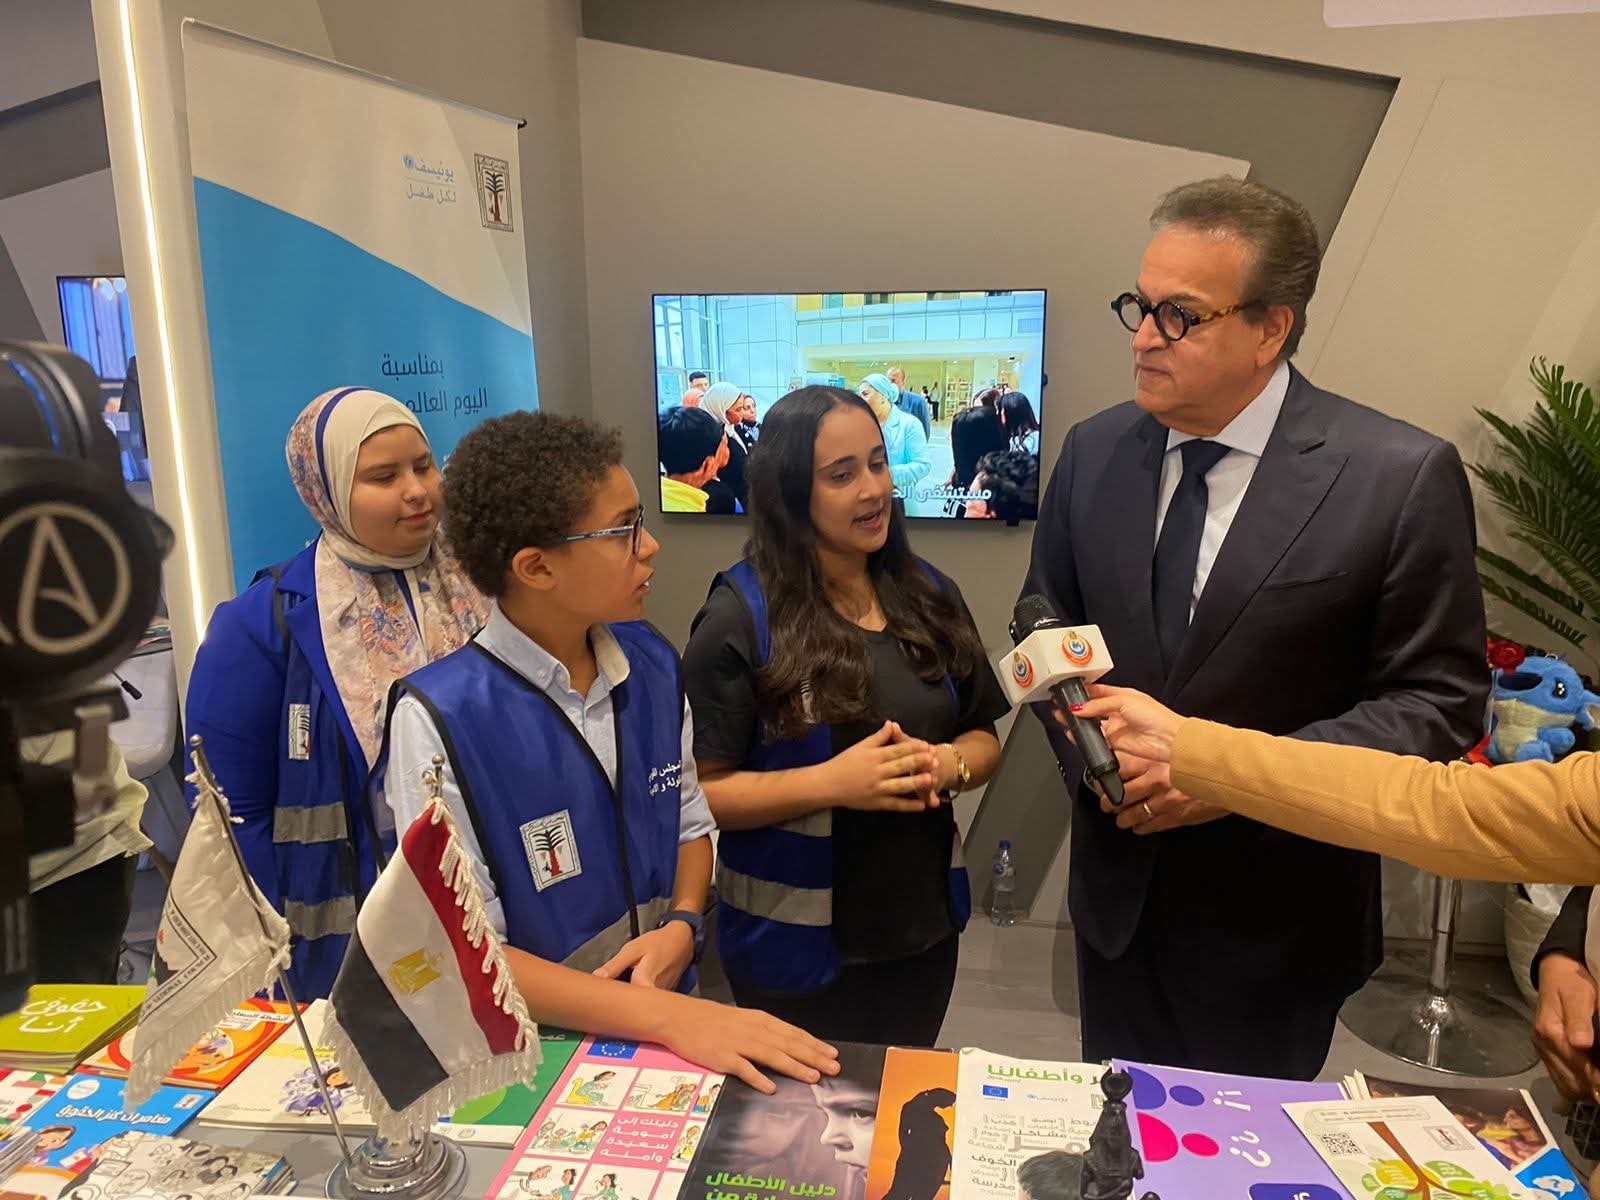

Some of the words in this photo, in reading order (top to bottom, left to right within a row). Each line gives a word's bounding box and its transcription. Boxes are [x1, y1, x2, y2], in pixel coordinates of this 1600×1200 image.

[406, 183, 434, 200] طفل
[437, 189, 457, 205] لكل
[381, 353, 446, 381] بمناسبة
[406, 390, 448, 413] العالم
[453, 387, 488, 418] اليوم
[987, 1064, 1084, 1084] وأطفالنا
[705, 1172, 786, 1192] الأطفال
[790, 1182, 836, 1197] دليل
